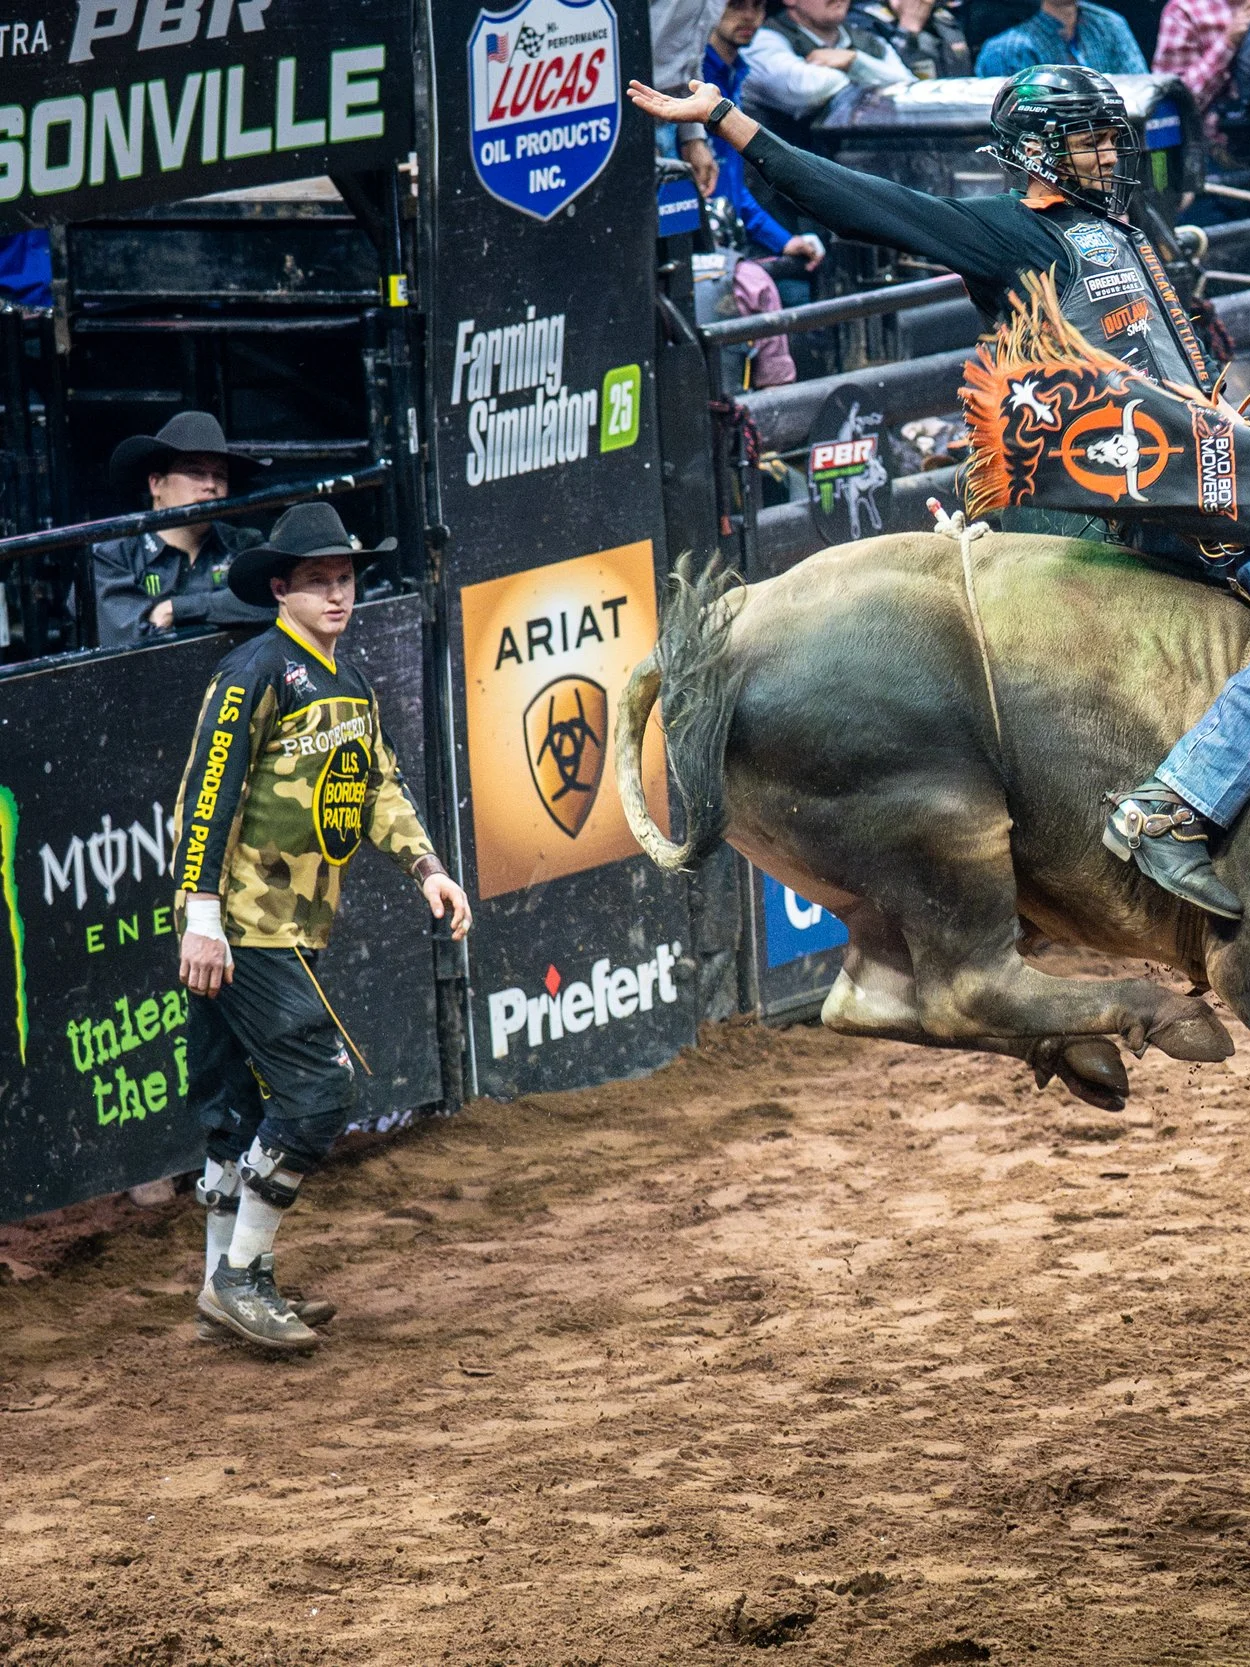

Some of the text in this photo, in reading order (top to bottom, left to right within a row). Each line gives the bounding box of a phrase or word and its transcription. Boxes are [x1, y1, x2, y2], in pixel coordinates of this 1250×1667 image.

[68, 0, 272, 64] PBR
[548, 28, 608, 48] PERFORMANCE
[488, 47, 606, 122] LUCAS
[1018, 105, 1048, 114] BAUER
[0, 44, 387, 201] SONVILLE
[481, 117, 611, 166] OIL PRODUCTS
[529, 165, 566, 193] INC.
[1088, 271, 1139, 292] BREEDLOVE
[1103, 300, 1148, 334] OUTLAW
[1140, 245, 1209, 381] OUTLAW ATTITUDE
[451, 305, 566, 405] Farming
[466, 380, 634, 487] Simulator 25
[814, 438, 874, 471] PBR
[1201, 435, 1218, 513] MOWERS
[1216, 437, 1232, 512] BAD BOY
[494, 596, 628, 672] ARIAT
[217, 685, 246, 725] U.S.
[281, 716, 365, 758] PROTECTED
[341, 751, 360, 774] U.S.
[193, 729, 234, 821] BORDER
[325, 781, 367, 804] BORDER
[323, 806, 362, 829] PATROL
[488, 942, 679, 1059] Priefert
[93, 1064, 168, 1128] the
